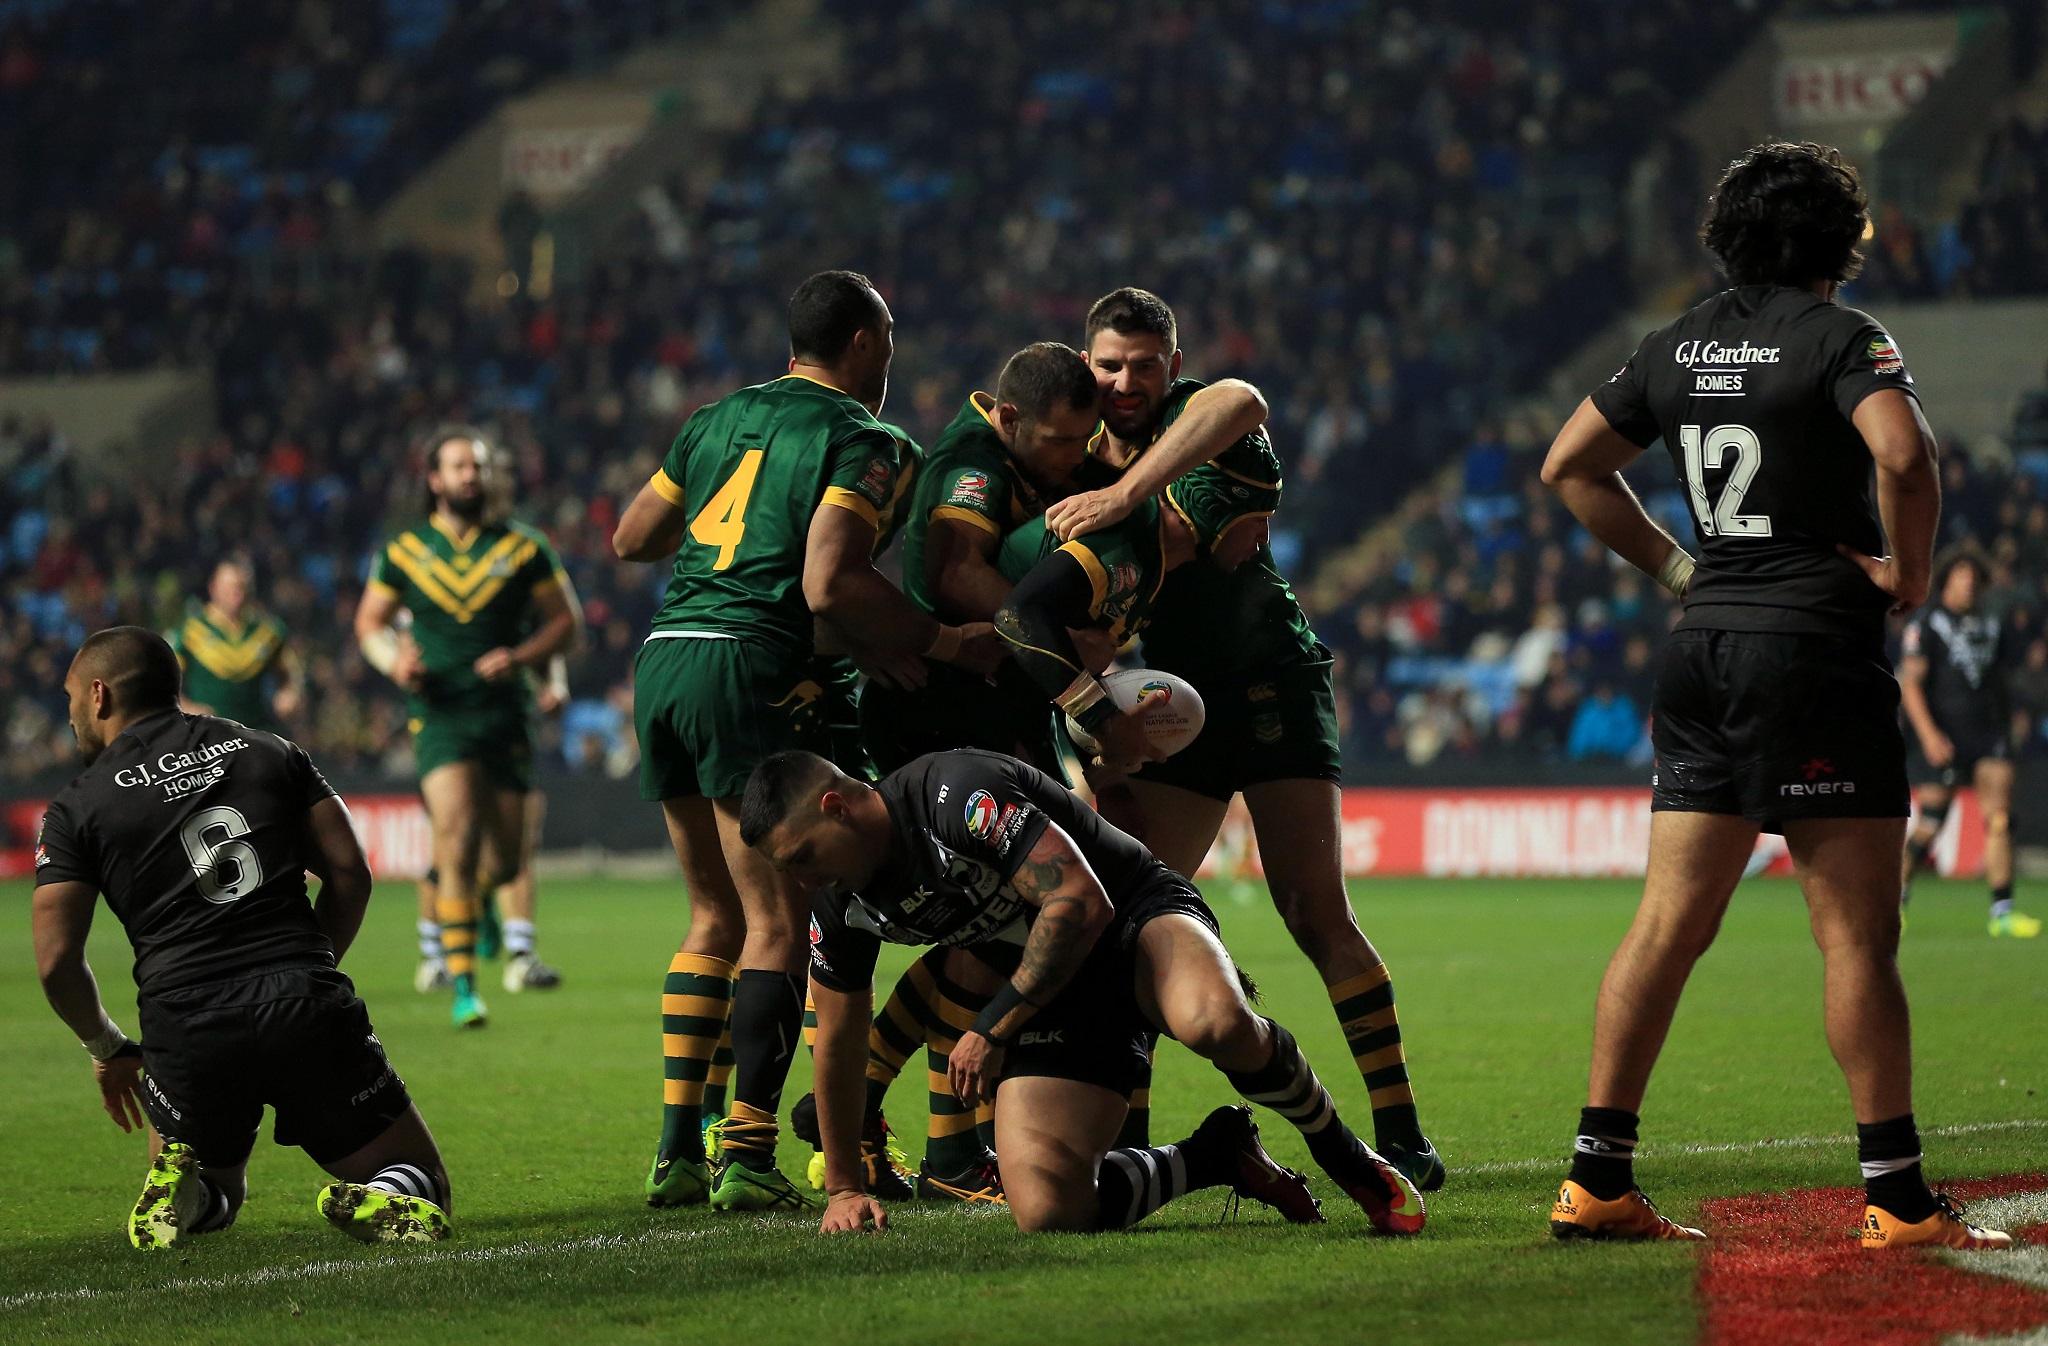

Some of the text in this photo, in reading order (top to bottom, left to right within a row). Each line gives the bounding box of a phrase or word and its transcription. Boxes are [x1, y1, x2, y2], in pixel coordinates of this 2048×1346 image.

[1695, 375, 1743, 392] HOMES
[1680, 424, 1773, 537] 12
[689, 449, 764, 571] 4
[114, 734, 249, 789] G.J. Gardner.
[164, 765, 225, 797] HOMES
[937, 784, 950, 805] 767
[1780, 781, 1855, 797] revera
[180, 805, 263, 905] 6
[1018, 1029, 1064, 1046] BLK
